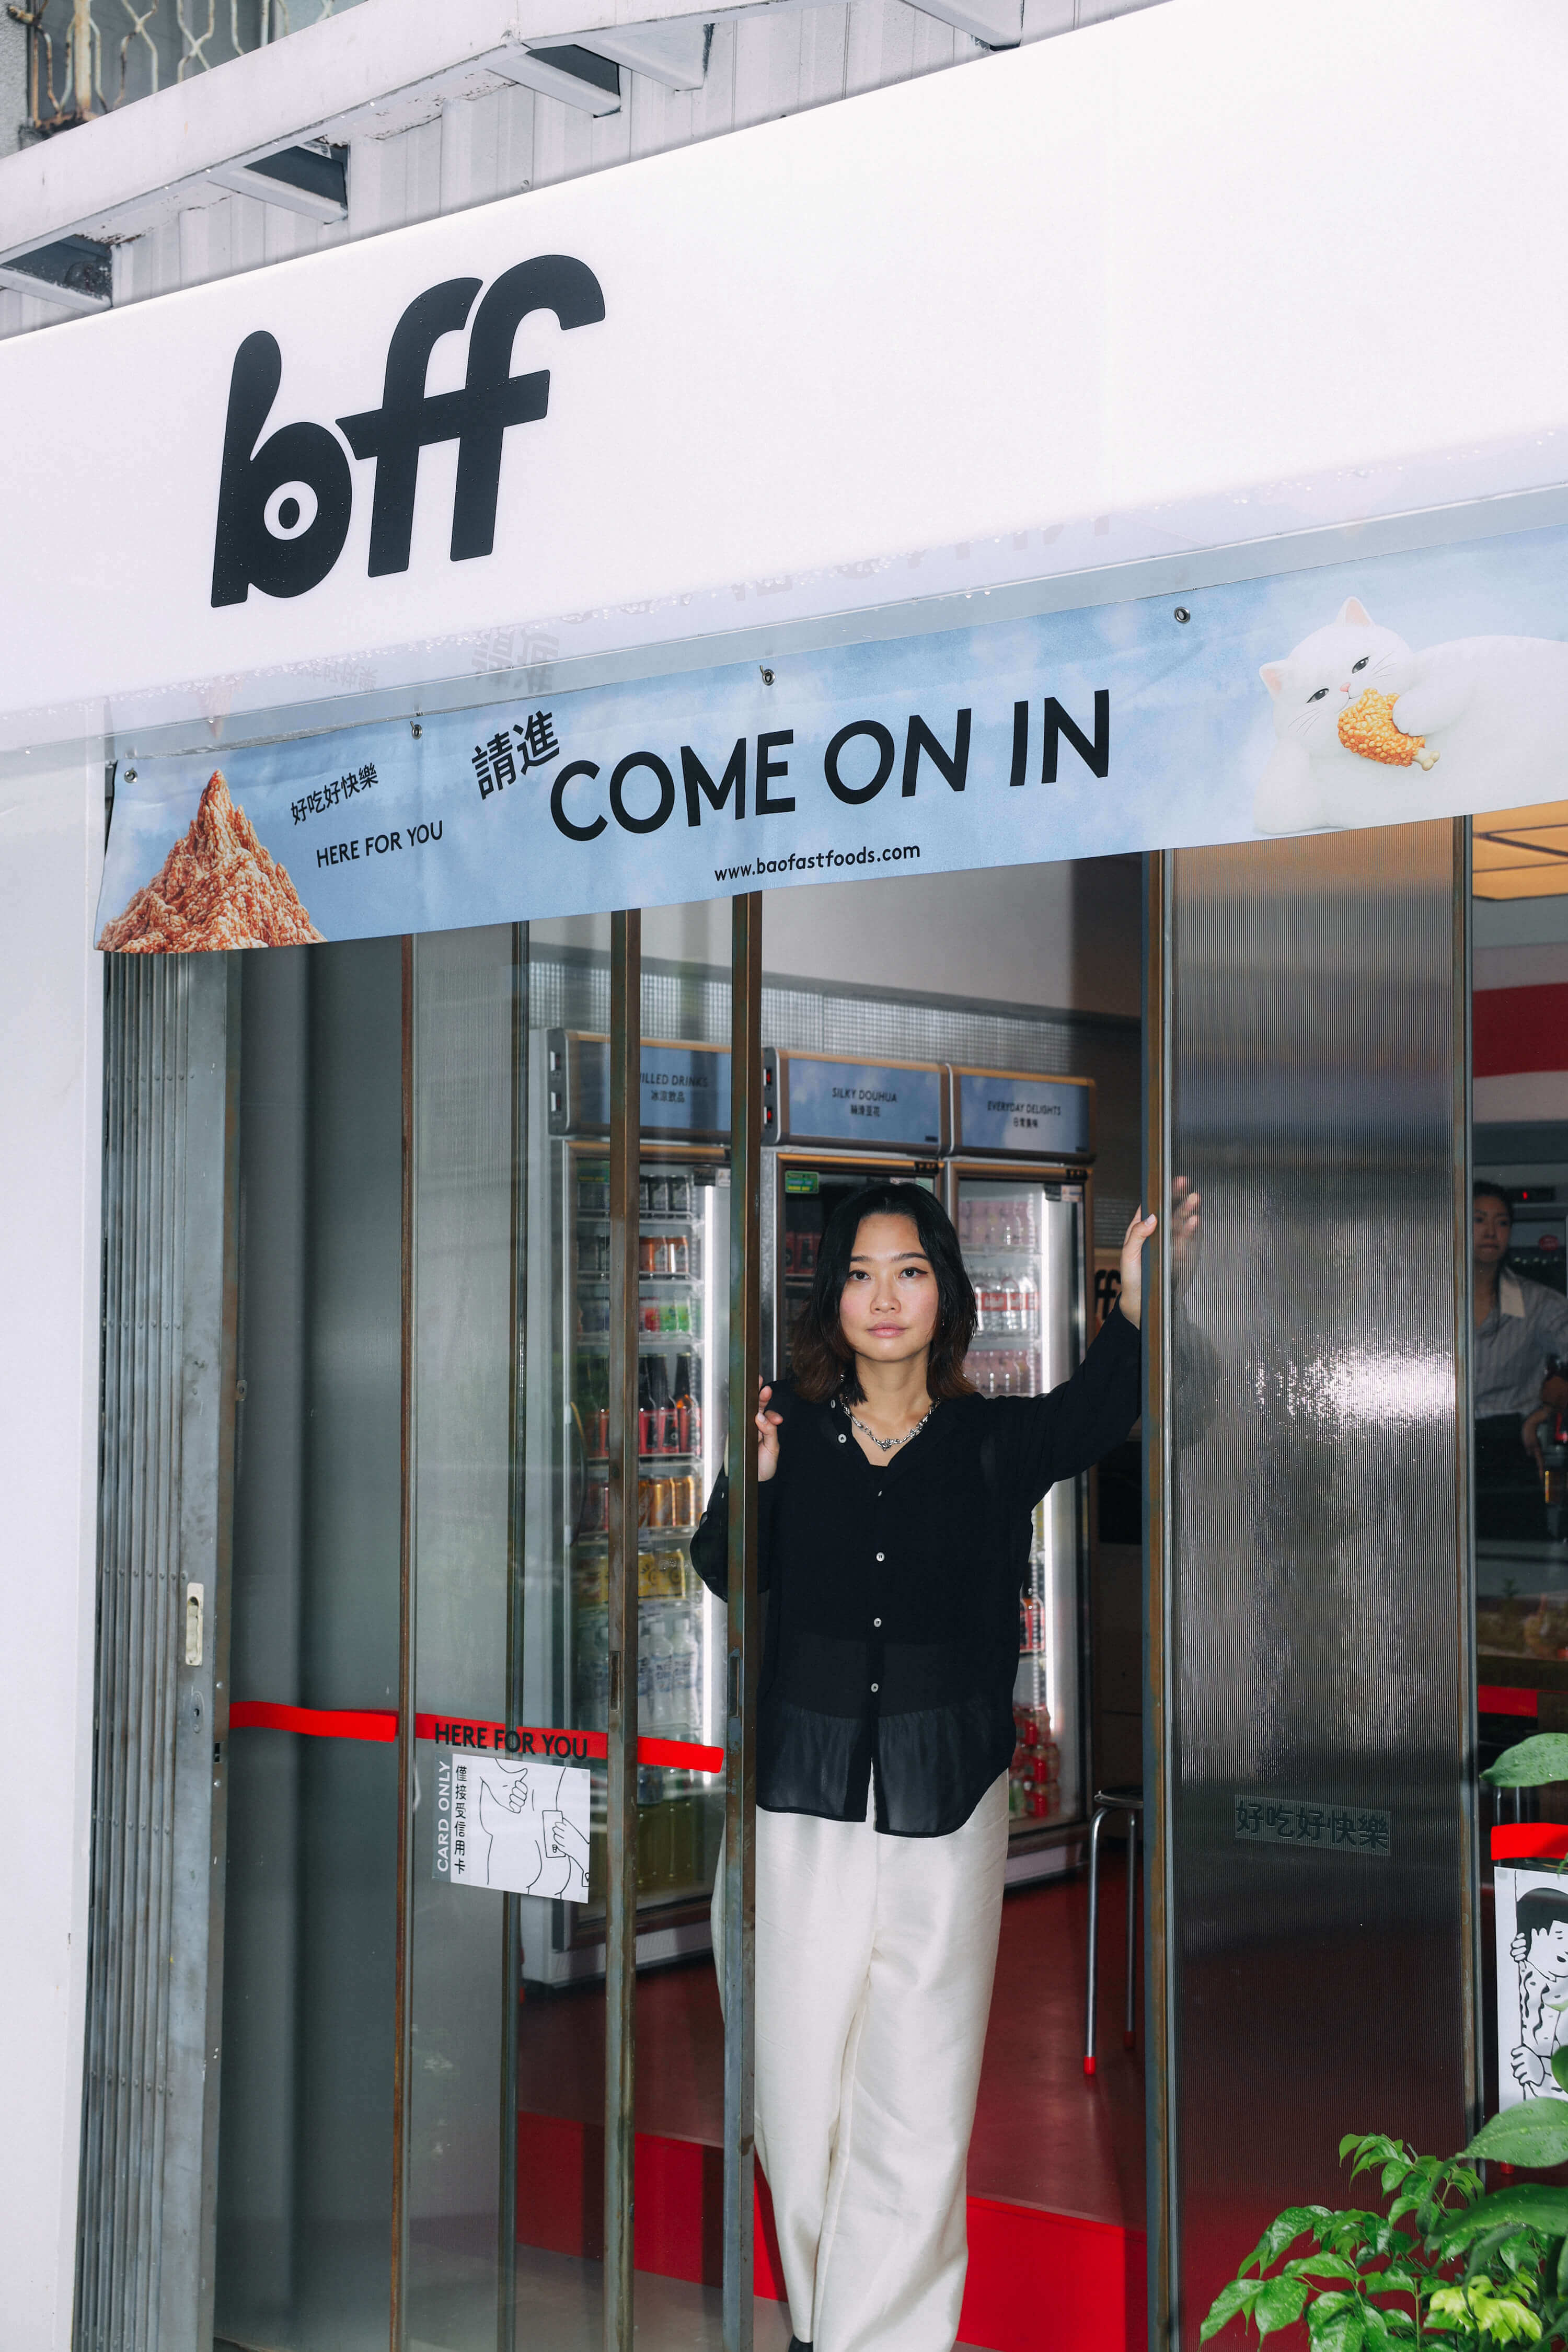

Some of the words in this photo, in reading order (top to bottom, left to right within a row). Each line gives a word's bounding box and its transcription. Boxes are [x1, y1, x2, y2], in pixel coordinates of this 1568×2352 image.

[211, 255, 605, 608] bff
[472, 710, 560, 800] 請進
[550, 730, 795, 841] COME
[824, 708, 971, 805] ON
[1010, 689, 1109, 787] IN
[291, 763, 378, 825] 好吃好快樂
[316, 840, 360, 868] HERE
[365, 832, 403, 857] FOR
[407, 820, 443, 847] YOU
[714, 845, 920, 882] www.baofastfoods.com
[640, 1073, 668, 1085] ILLED
[672, 1075, 708, 1088] DRINKS
[832, 1088, 857, 1098] SILKY
[859, 1090, 897, 1102] DOUHUA
[987, 1100, 1024, 1112] EVERYDAY
[1026, 1103, 1061, 1116] DELIGHTS
[1095, 1270, 1121, 1320] ff
[435, 1723, 487, 1749] HERE
[494, 1729, 536, 1755] FOR
[541, 1734, 587, 1760] YOU
[438, 1760, 451, 1811] ONLY
[454, 1765, 468, 1874] 僅接受信用卡
[1235, 1801, 1389, 1850] 好吃好快樂
[437, 1818, 449, 1872] CARD
